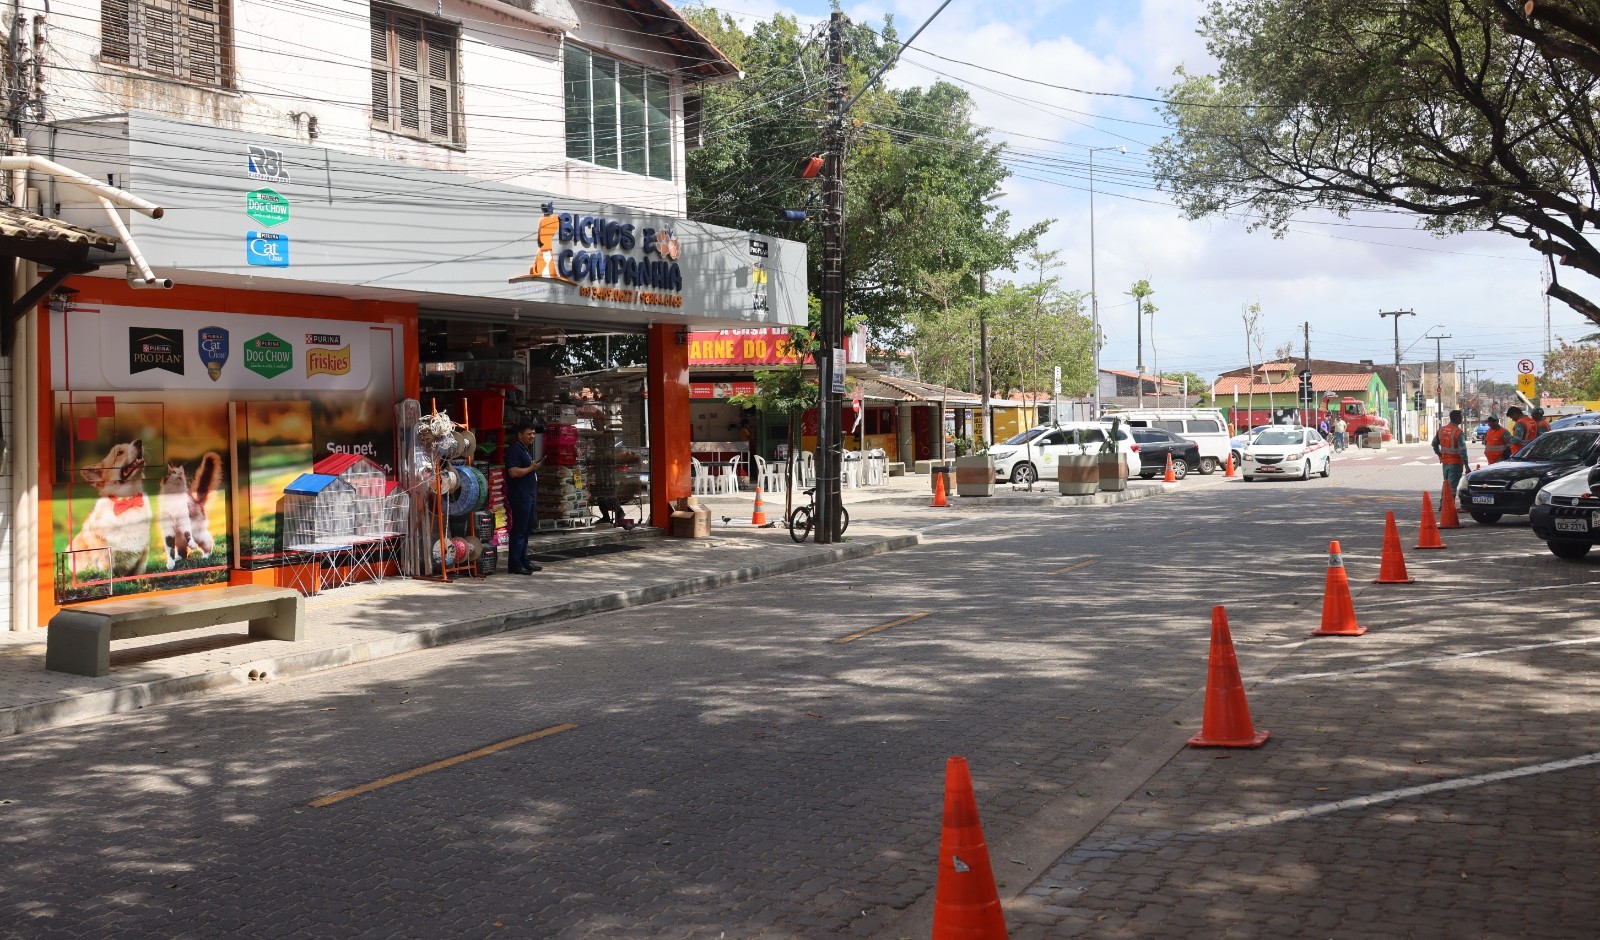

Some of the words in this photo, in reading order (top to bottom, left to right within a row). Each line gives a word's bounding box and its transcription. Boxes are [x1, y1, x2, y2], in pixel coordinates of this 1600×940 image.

[559, 212, 636, 251] BICHOS
[250, 238, 280, 257] Cat
[558, 248, 682, 293] COMPANHIA
[201, 340, 221, 351] Cat
[313, 336, 340, 344] PURINA
[149, 345, 171, 353] PURINA
[246, 349, 264, 362] DOG
[265, 349, 290, 363] CHOW
[690, 340, 735, 359] ARNE
[743, 340, 767, 359] DO
[309, 353, 348, 371] Friskies
[326, 442, 350, 455] Seu
